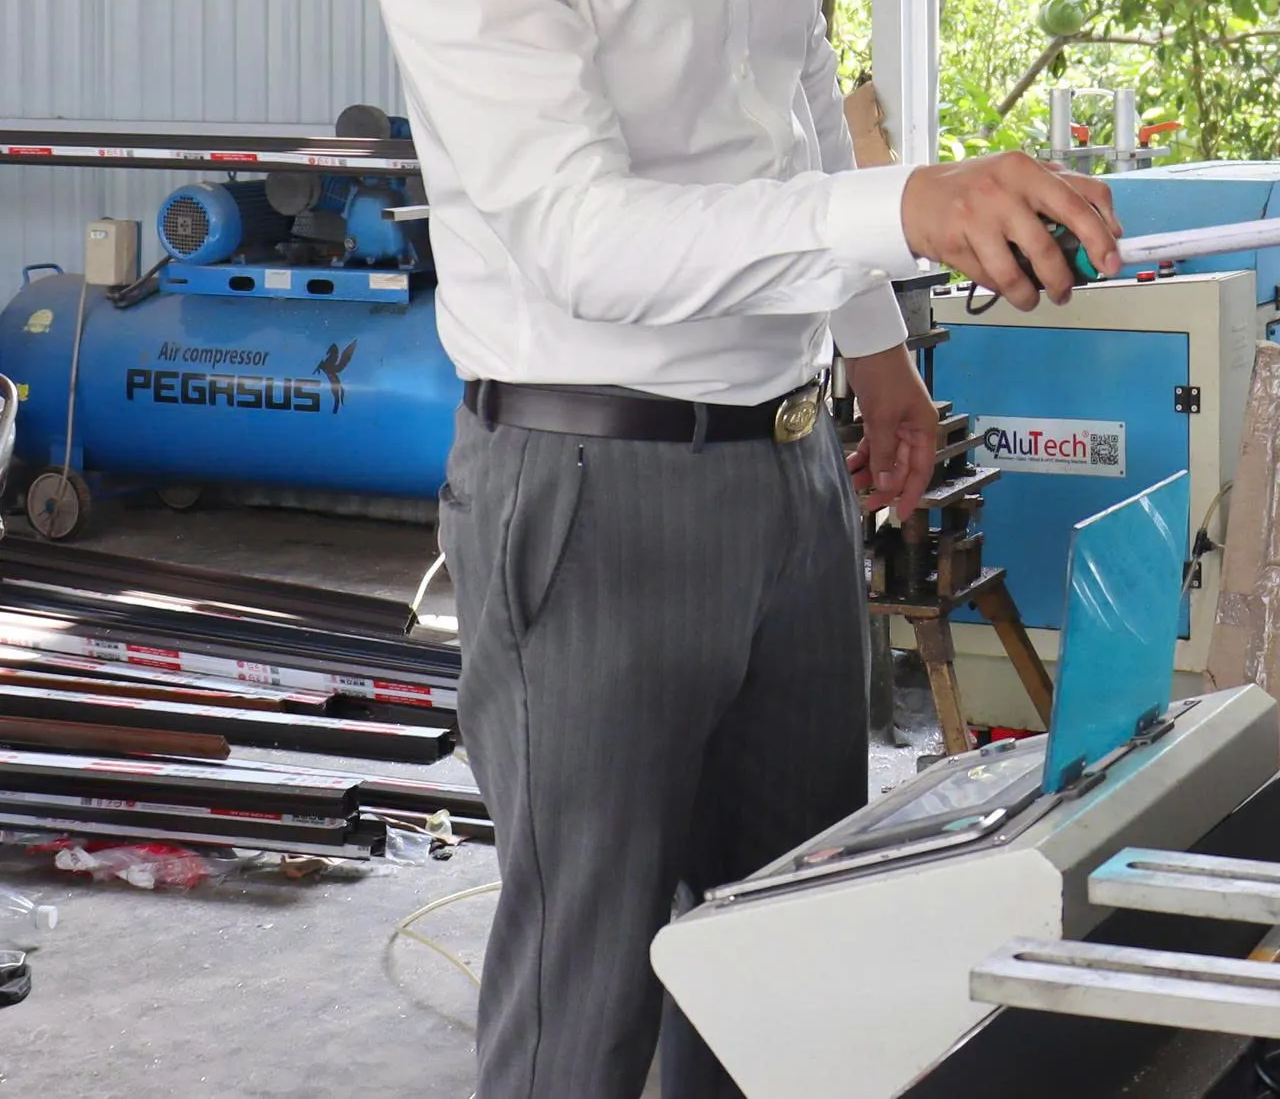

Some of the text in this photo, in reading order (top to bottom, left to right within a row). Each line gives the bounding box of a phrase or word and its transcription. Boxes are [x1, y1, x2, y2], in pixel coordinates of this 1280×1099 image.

[158, 342, 269, 369] Air compressor
[126, 368, 321, 412] PEGASUS
